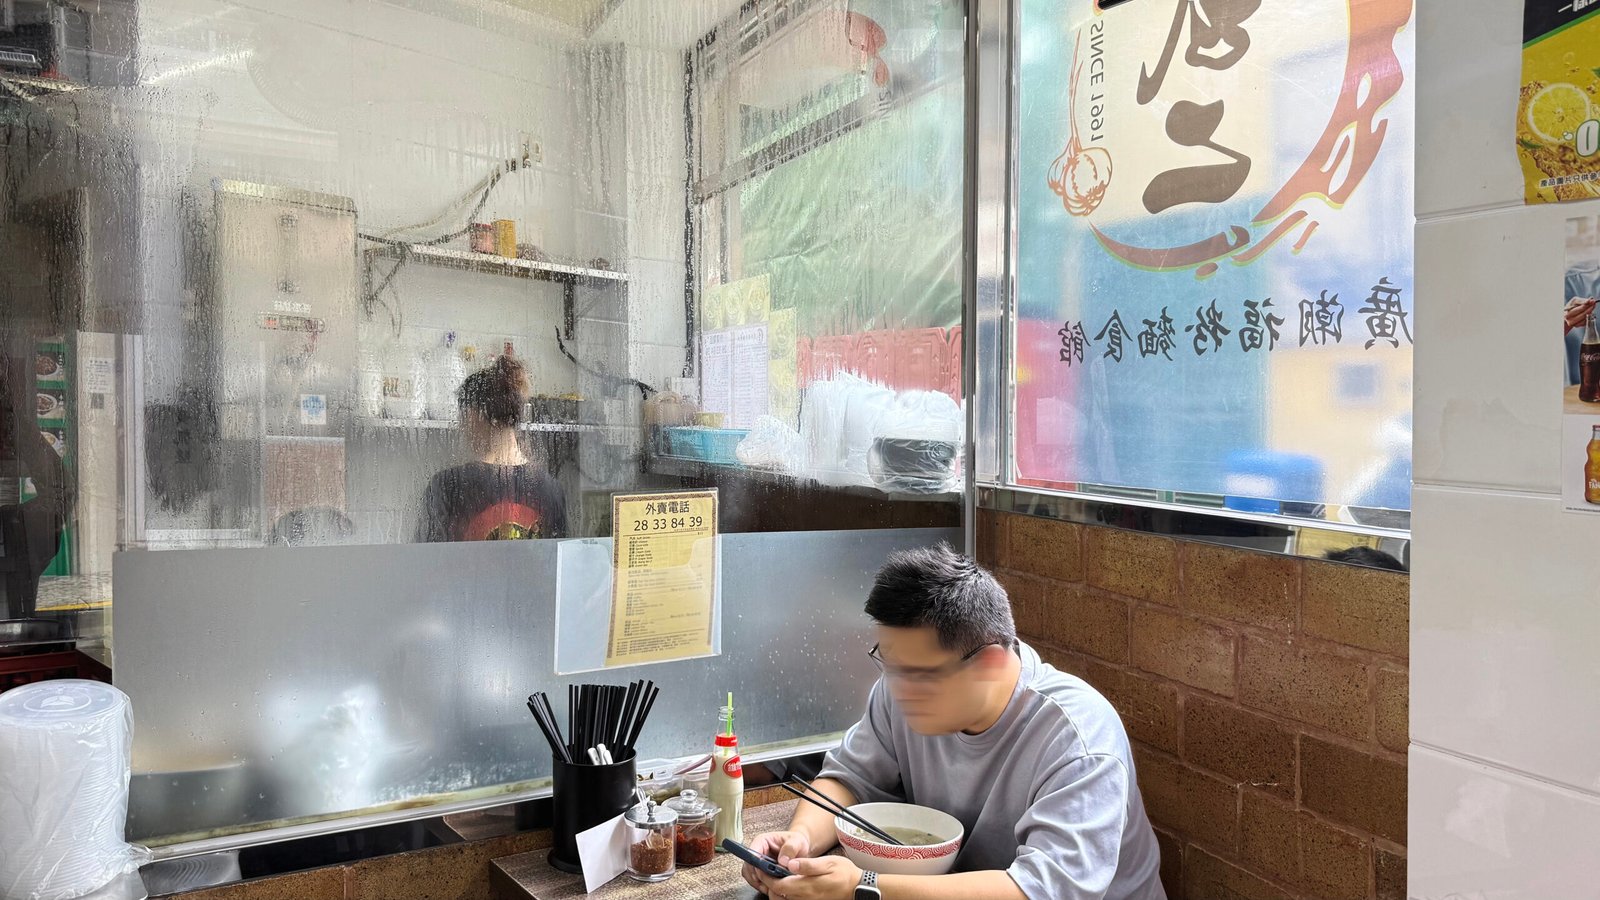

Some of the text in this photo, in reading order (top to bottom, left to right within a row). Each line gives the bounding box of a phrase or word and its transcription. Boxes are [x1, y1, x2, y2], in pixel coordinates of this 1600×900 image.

[1540, 172, 1600, 187] 產品圖片只供參
[645, 500, 690, 516] 外賣電話
[634, 520, 648, 531] 28
[653, 519, 666, 530] 33
[671, 517, 685, 528] 84
[689, 516, 703, 527] 39
